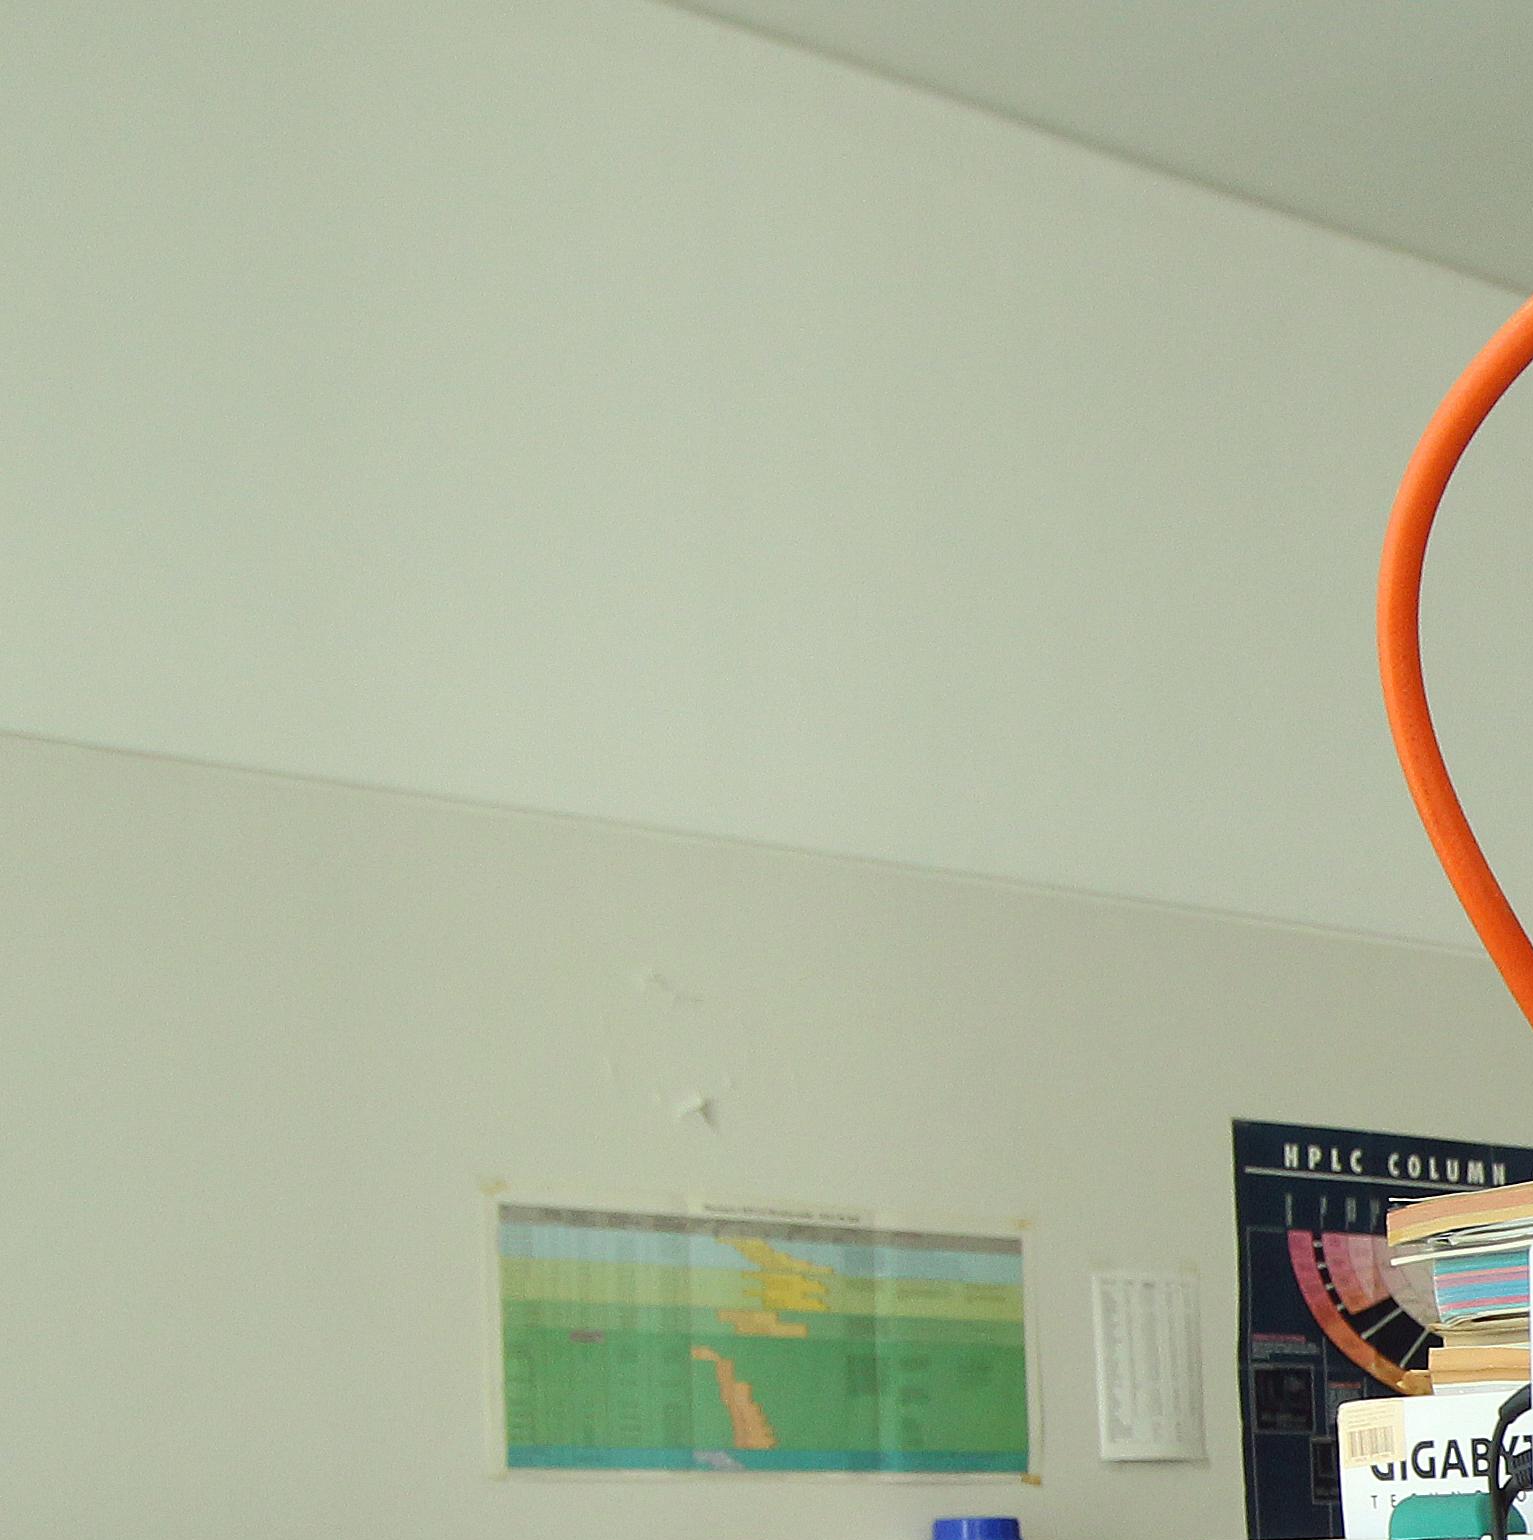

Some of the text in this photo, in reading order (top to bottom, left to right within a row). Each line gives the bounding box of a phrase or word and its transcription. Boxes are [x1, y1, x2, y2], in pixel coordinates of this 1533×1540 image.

[1283, 1143, 1364, 1175] HPLC
[1387, 1152, 1506, 1187] COLUMN
[1370, 1434, 1533, 1482] GIGABY
